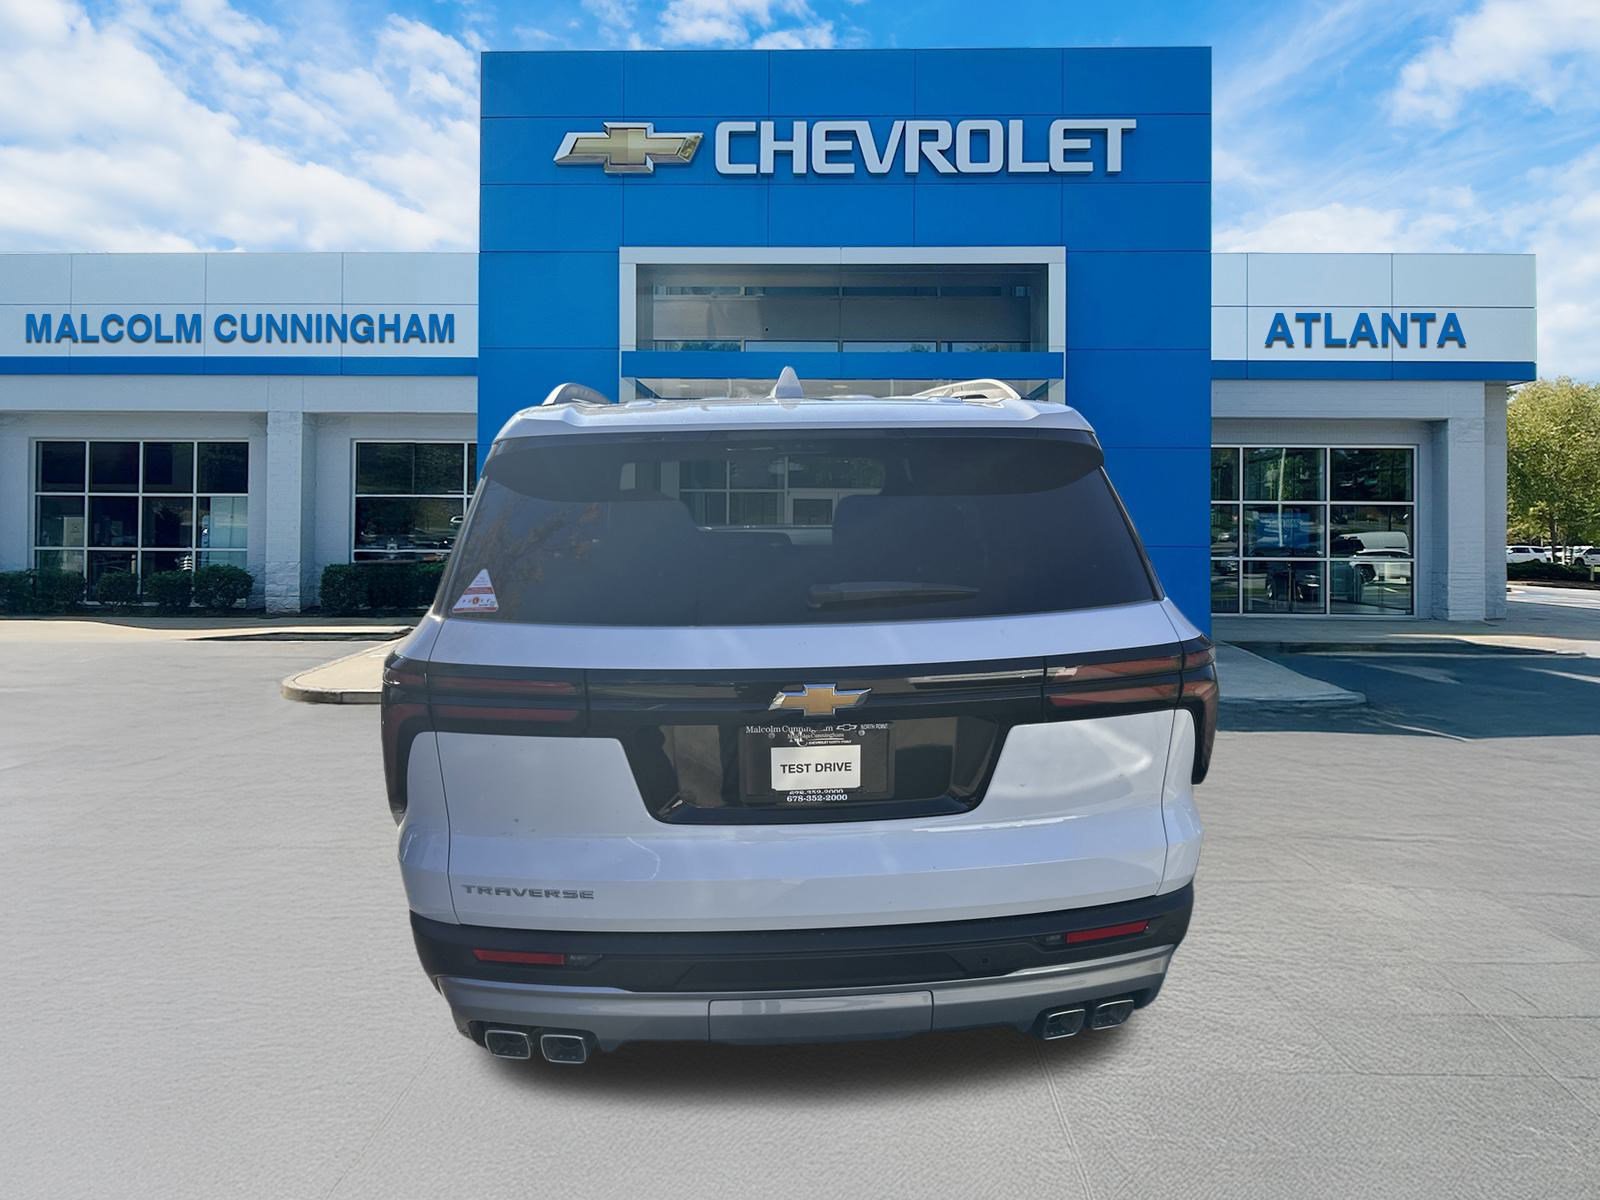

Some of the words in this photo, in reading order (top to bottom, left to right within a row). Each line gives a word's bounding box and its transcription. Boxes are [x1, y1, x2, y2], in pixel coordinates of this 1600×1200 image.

[715, 119, 1137, 174] CHEVROLET
[25, 313, 201, 343] MALCOLM
[213, 313, 456, 343] CUNNINGHAM
[1264, 312, 1467, 348] ATLANTA
[745, 725, 781, 734] Malcolm
[782, 725, 833, 734] Cunninm
[780, 763, 811, 774] TEST
[815, 762, 852, 773] DRIVE
[786, 794, 848, 802] 678-352-2000
[461, 884, 595, 900] TRAVERSE
